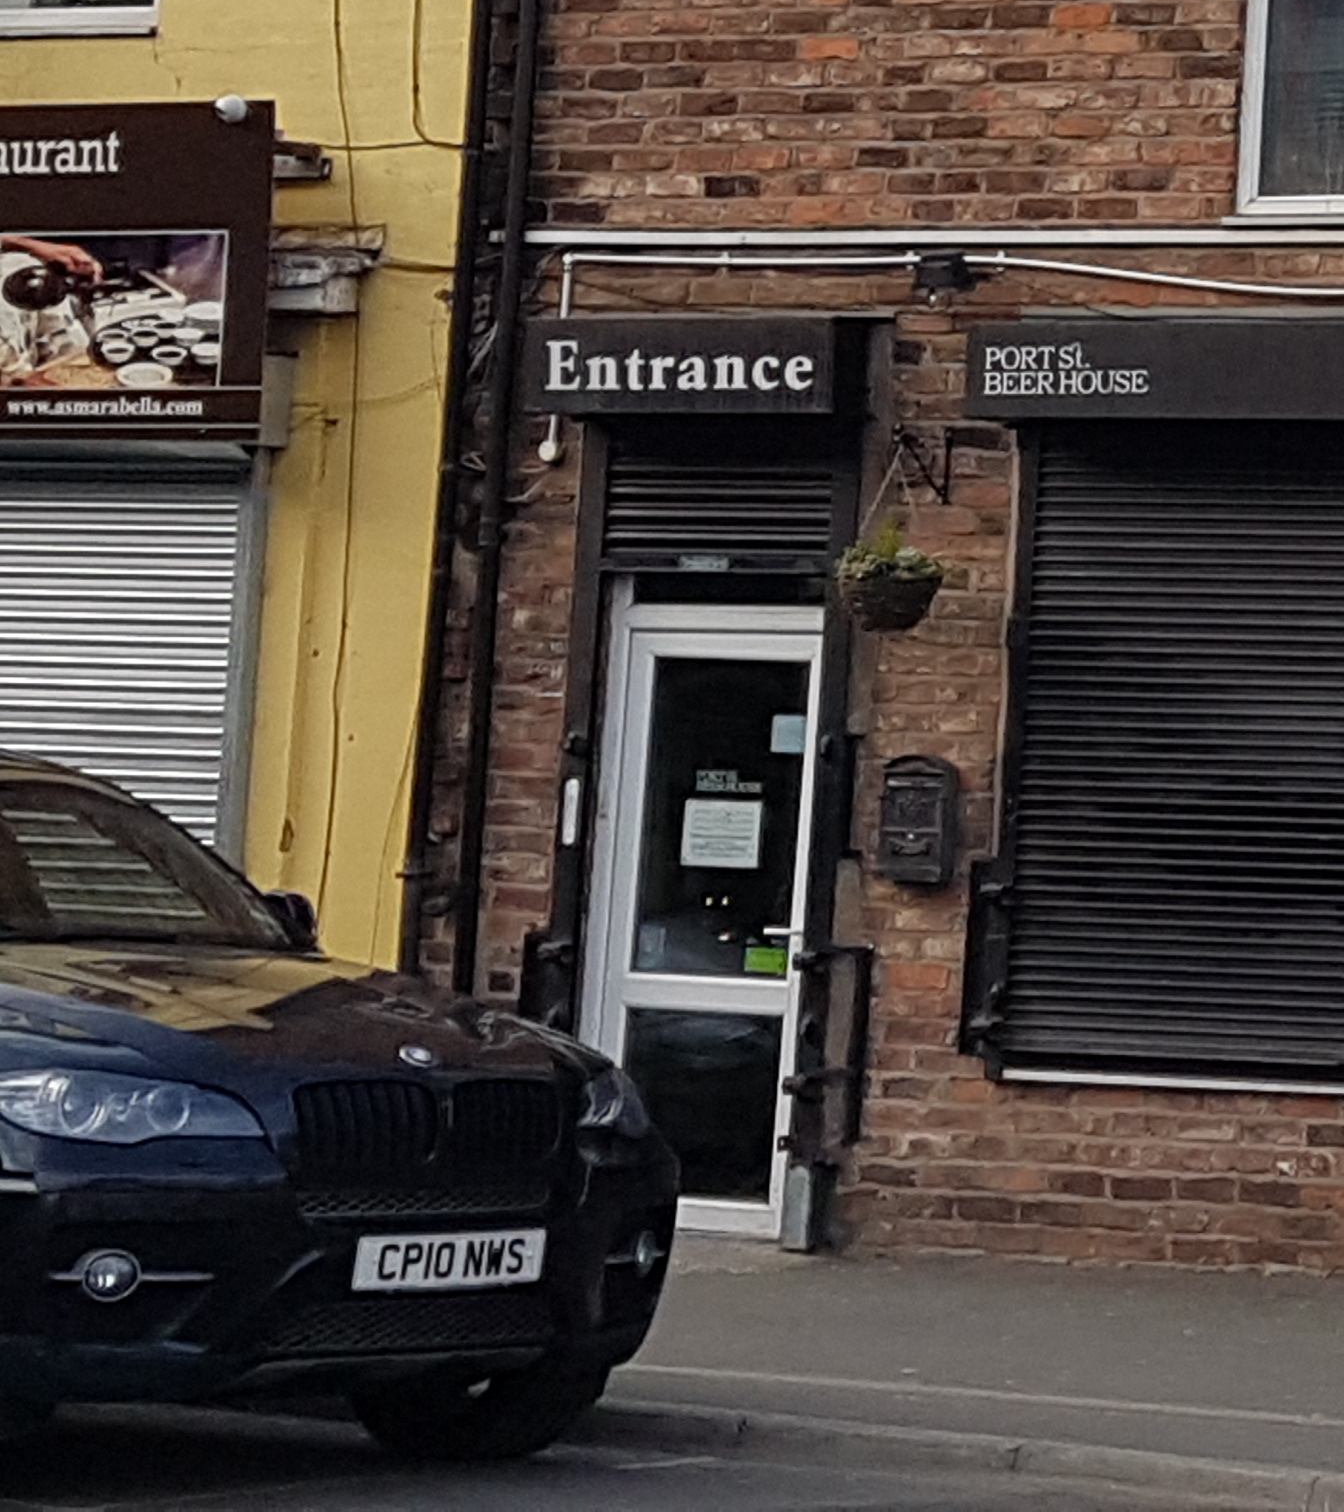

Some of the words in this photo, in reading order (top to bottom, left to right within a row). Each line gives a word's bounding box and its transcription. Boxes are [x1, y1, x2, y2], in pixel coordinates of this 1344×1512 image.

[545, 340, 815, 391] Entrance
[985, 345, 1055, 370] PORT
[983, 371, 1055, 395] BEER
[1058, 370, 1149, 395] HOUSE
[7, 396, 203, 416] www.asmarabella.com
[377, 1242, 456, 1281] CP10
[462, 1238, 526, 1278] NWS
